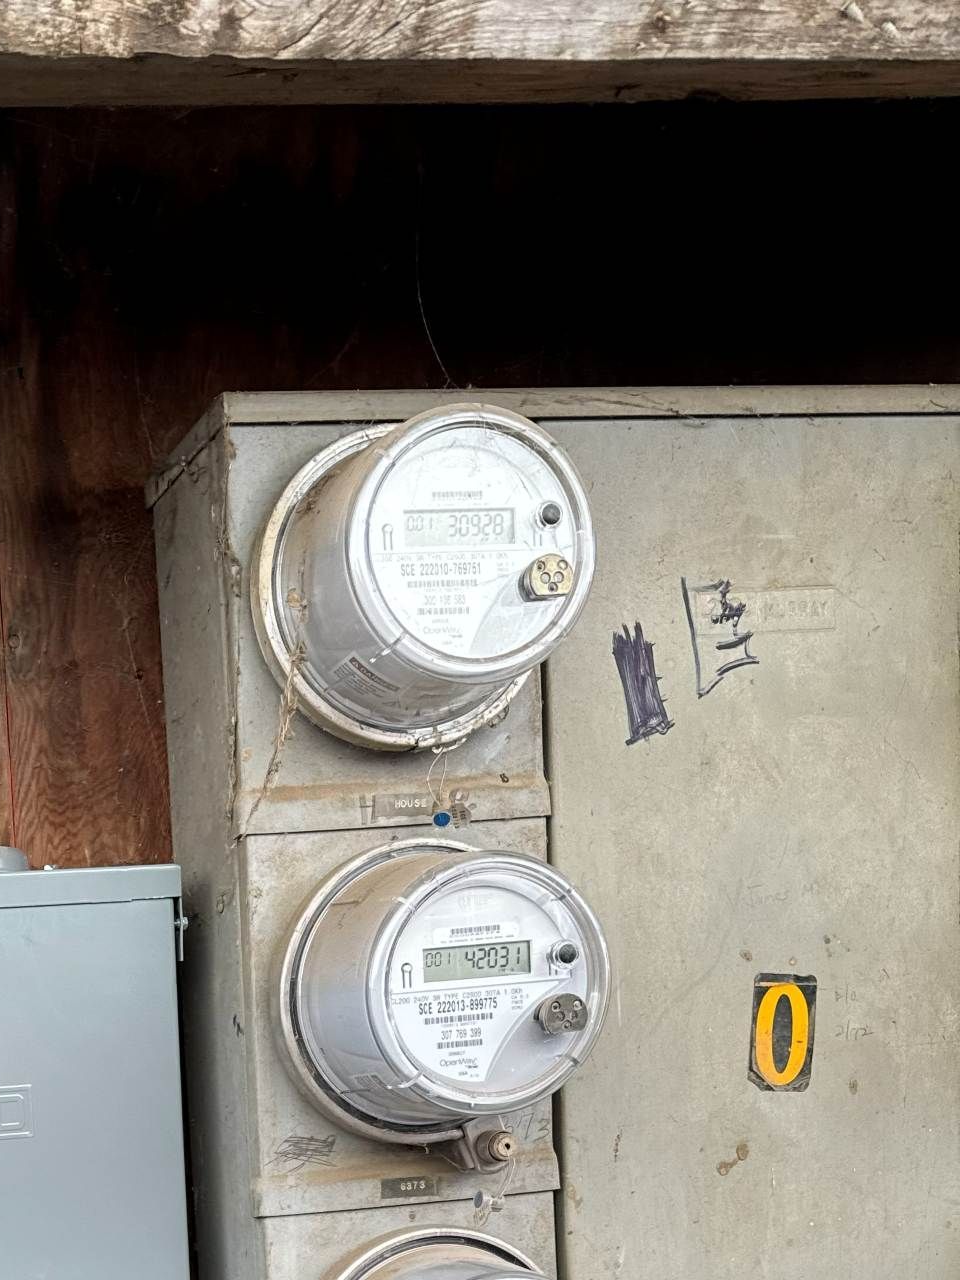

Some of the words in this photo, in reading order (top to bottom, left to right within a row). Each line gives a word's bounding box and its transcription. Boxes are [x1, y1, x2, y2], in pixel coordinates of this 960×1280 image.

[400, 563, 416, 577] SCE
[393, 798, 428, 809] HOUSE
[464, 945, 521, 970] 42031
[419, 1002, 433, 1016] SCE
[437, 997, 498, 1014] 222013-899775
[441, 1029, 453, 1040] 307
